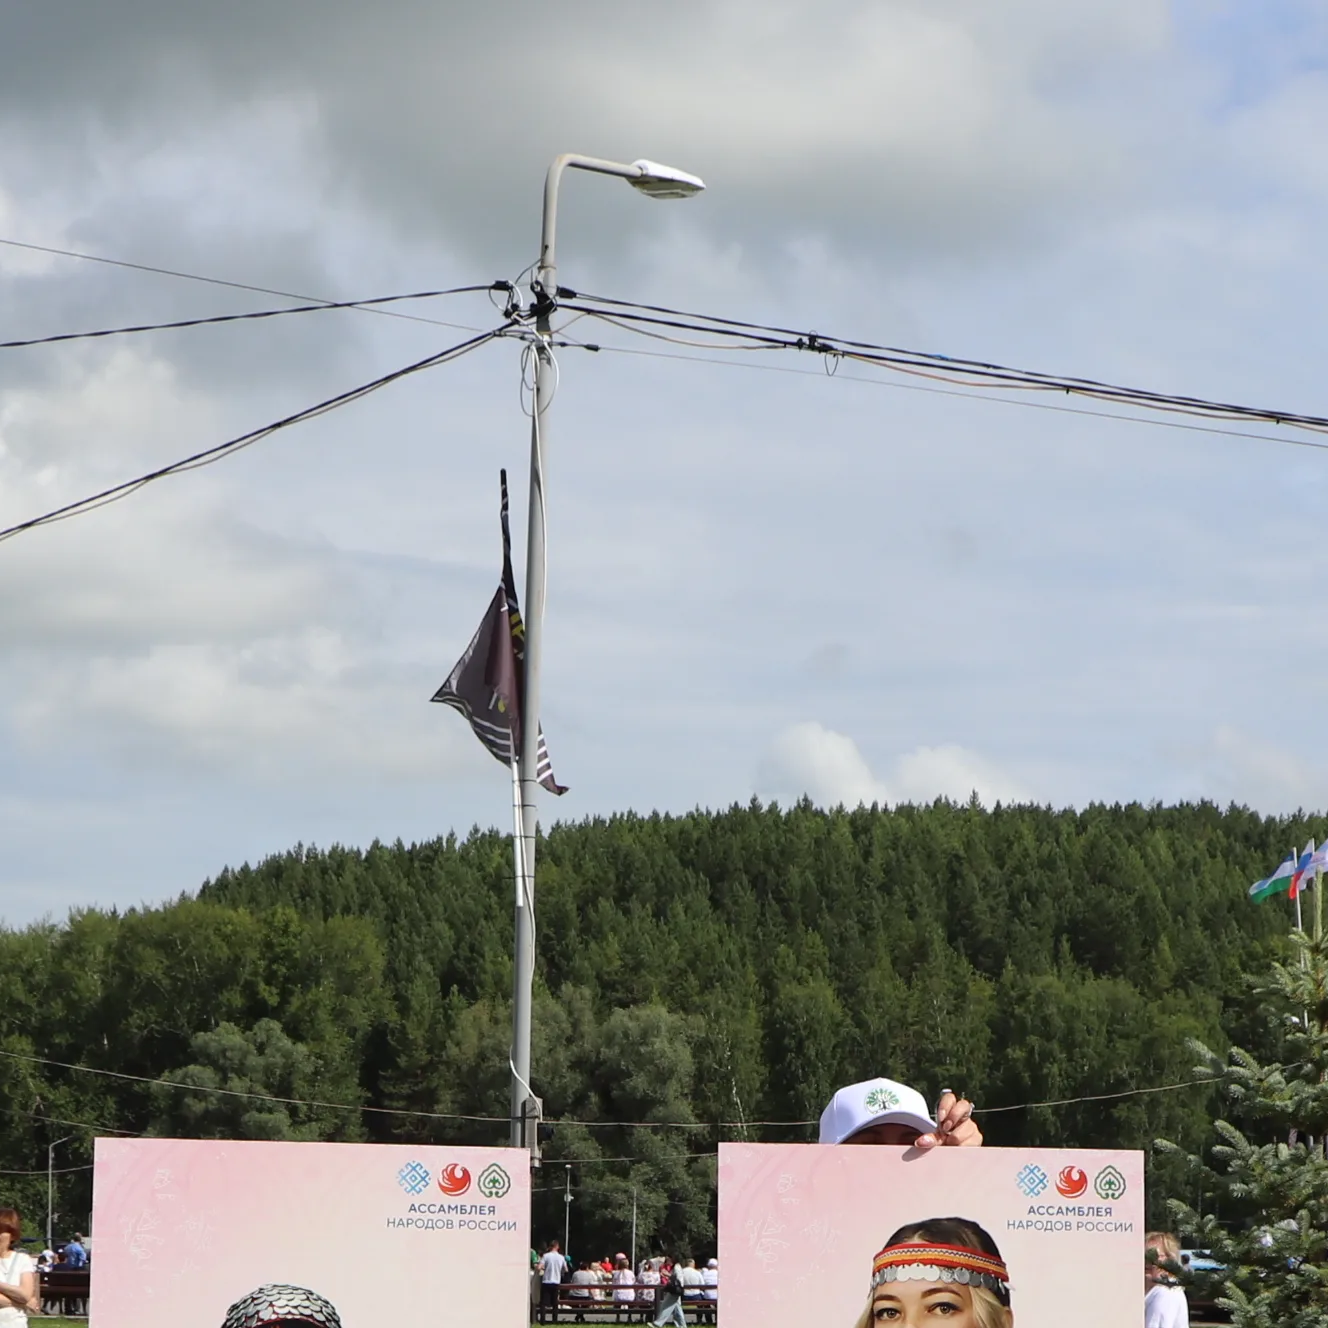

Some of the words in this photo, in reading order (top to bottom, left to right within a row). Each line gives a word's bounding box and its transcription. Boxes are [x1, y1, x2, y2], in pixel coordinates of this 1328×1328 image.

[408, 1203, 496, 1216] АССАМБЛЕЯ
[1027, 1205, 1113, 1217] АССАМБЛЕЯ
[386, 1218, 454, 1231] НАРОДОВ
[458, 1220, 517, 1232] РОССИИ
[1006, 1220, 1072, 1233] НАРОДОВ
[1076, 1221, 1133, 1233] РОССИИ
